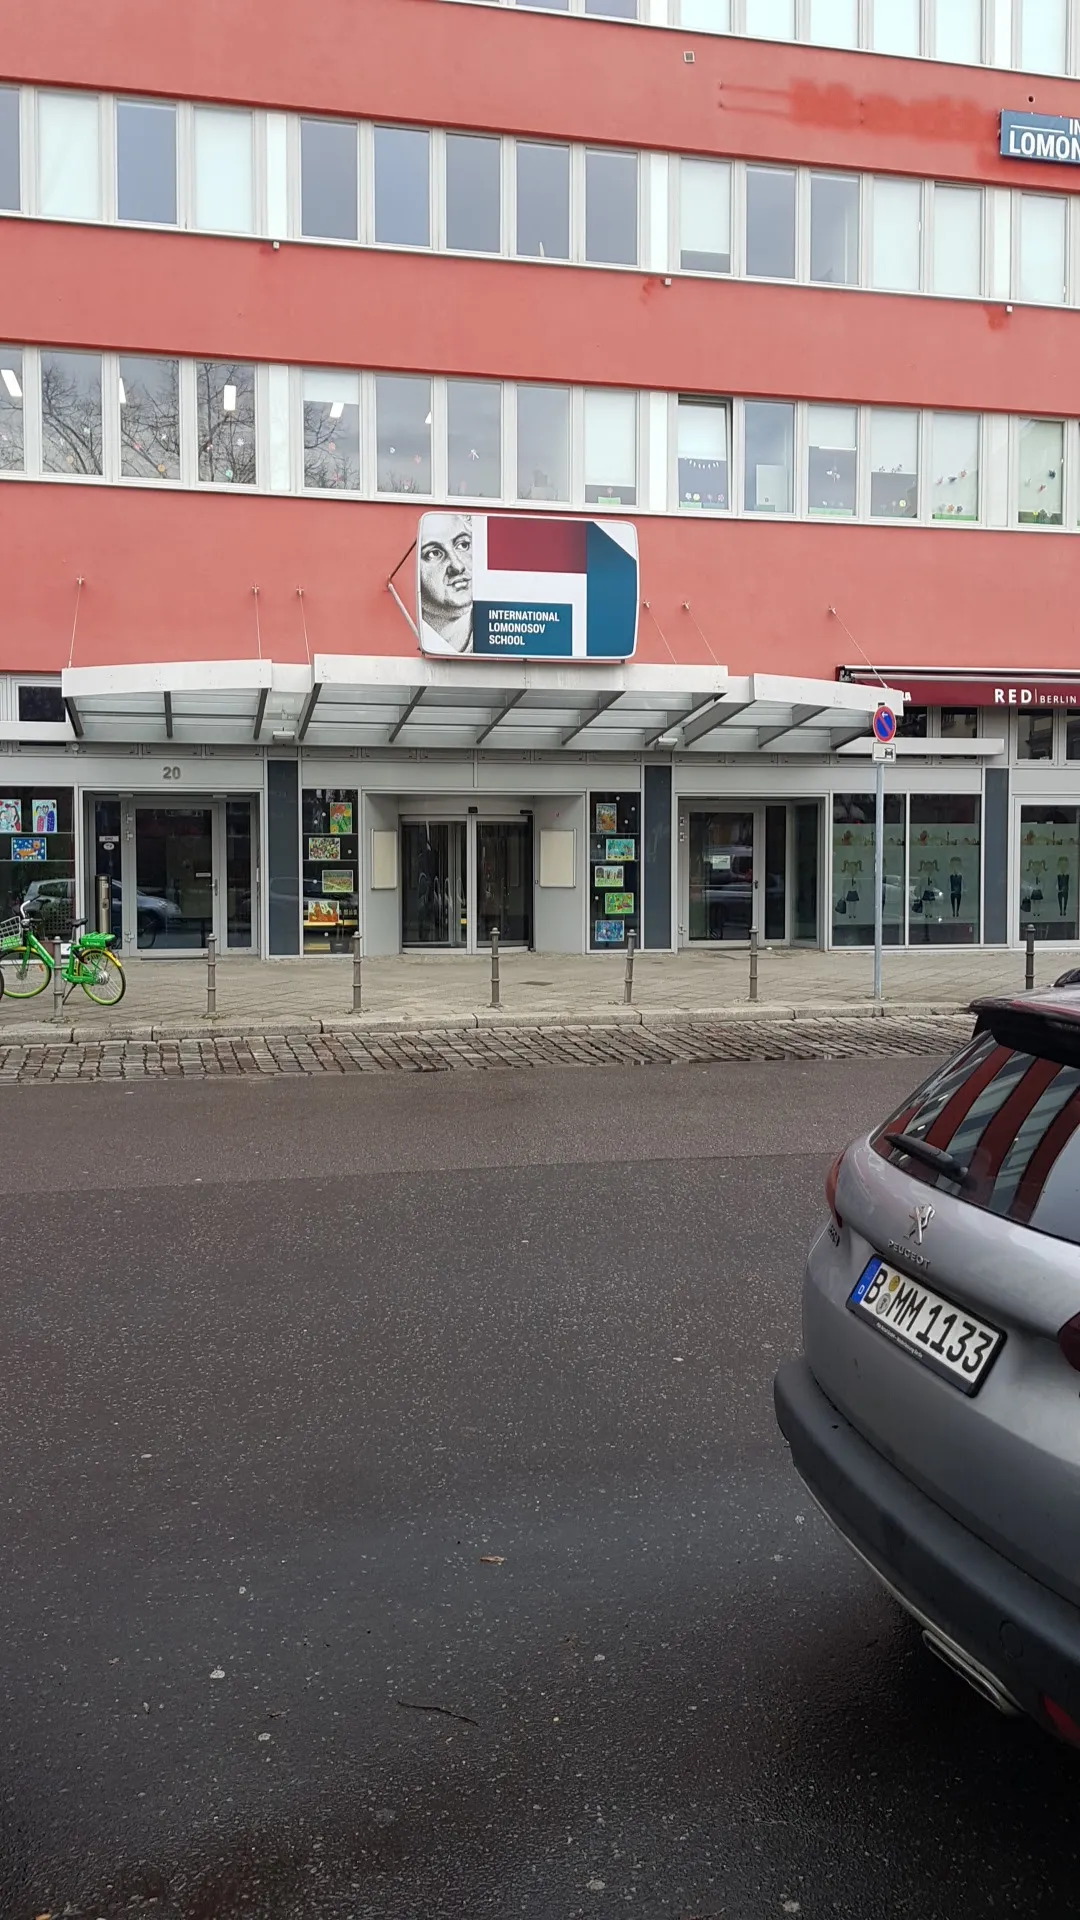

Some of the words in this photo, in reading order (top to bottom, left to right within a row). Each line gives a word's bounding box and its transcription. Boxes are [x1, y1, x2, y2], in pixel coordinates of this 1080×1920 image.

[488, 609, 560, 622] INTERNATIONAL
[488, 622, 546, 634] LOMONOSOV
[488, 634, 526, 646] SCHOOL
[994, 688, 1033, 704] RED
[1040, 695, 1077, 704] BERLIN
[163, 766, 181, 780] 20
[888, 1239, 931, 1270] PEUGEOT
